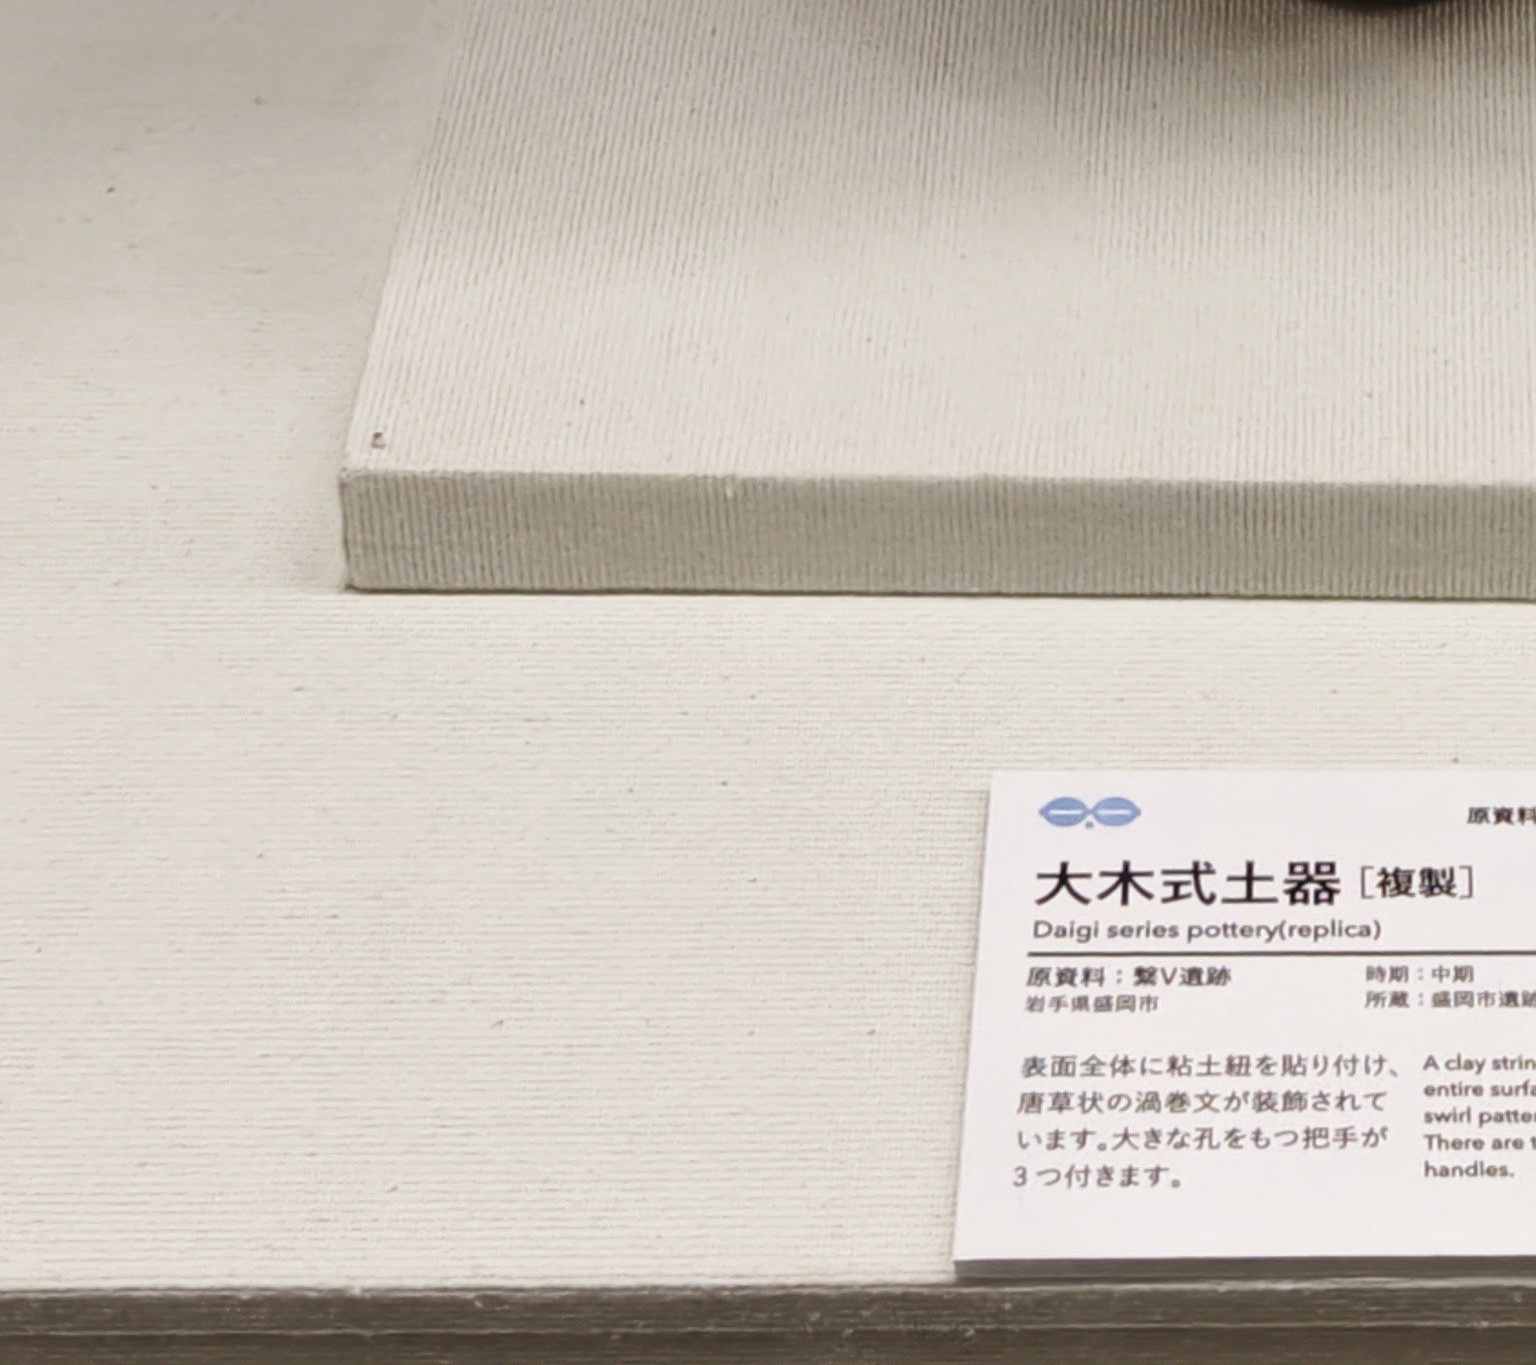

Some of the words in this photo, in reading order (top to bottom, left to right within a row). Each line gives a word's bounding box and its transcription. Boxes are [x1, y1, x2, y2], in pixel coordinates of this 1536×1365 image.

[1034, 859, 1342, 908] 大木式土器
[1032, 919, 1100, 945] Daigi
[1106, 919, 1180, 940] series
[1186, 917, 1382, 945] pottery(replica)
[1024, 993, 1159, 1014] 岩手県盛岡市
[1020, 1053, 1399, 1079] 表面全体に粘土紐を貼り付け、
[1422, 1054, 1440, 1072] A
[1443, 1052, 1487, 1076] clay
[1422, 1080, 1485, 1098] entire
[1016, 1089, 1388, 1116] 唐草状の渦巻文が装飾されて
[1423, 1105, 1472, 1125] swirl
[1016, 1125, 1389, 1152] います。大きな孔をもつ把手が
[1422, 1133, 1486, 1152] There
[1490, 1137, 1526, 1152] are
[1423, 1159, 1515, 1179] handles.
